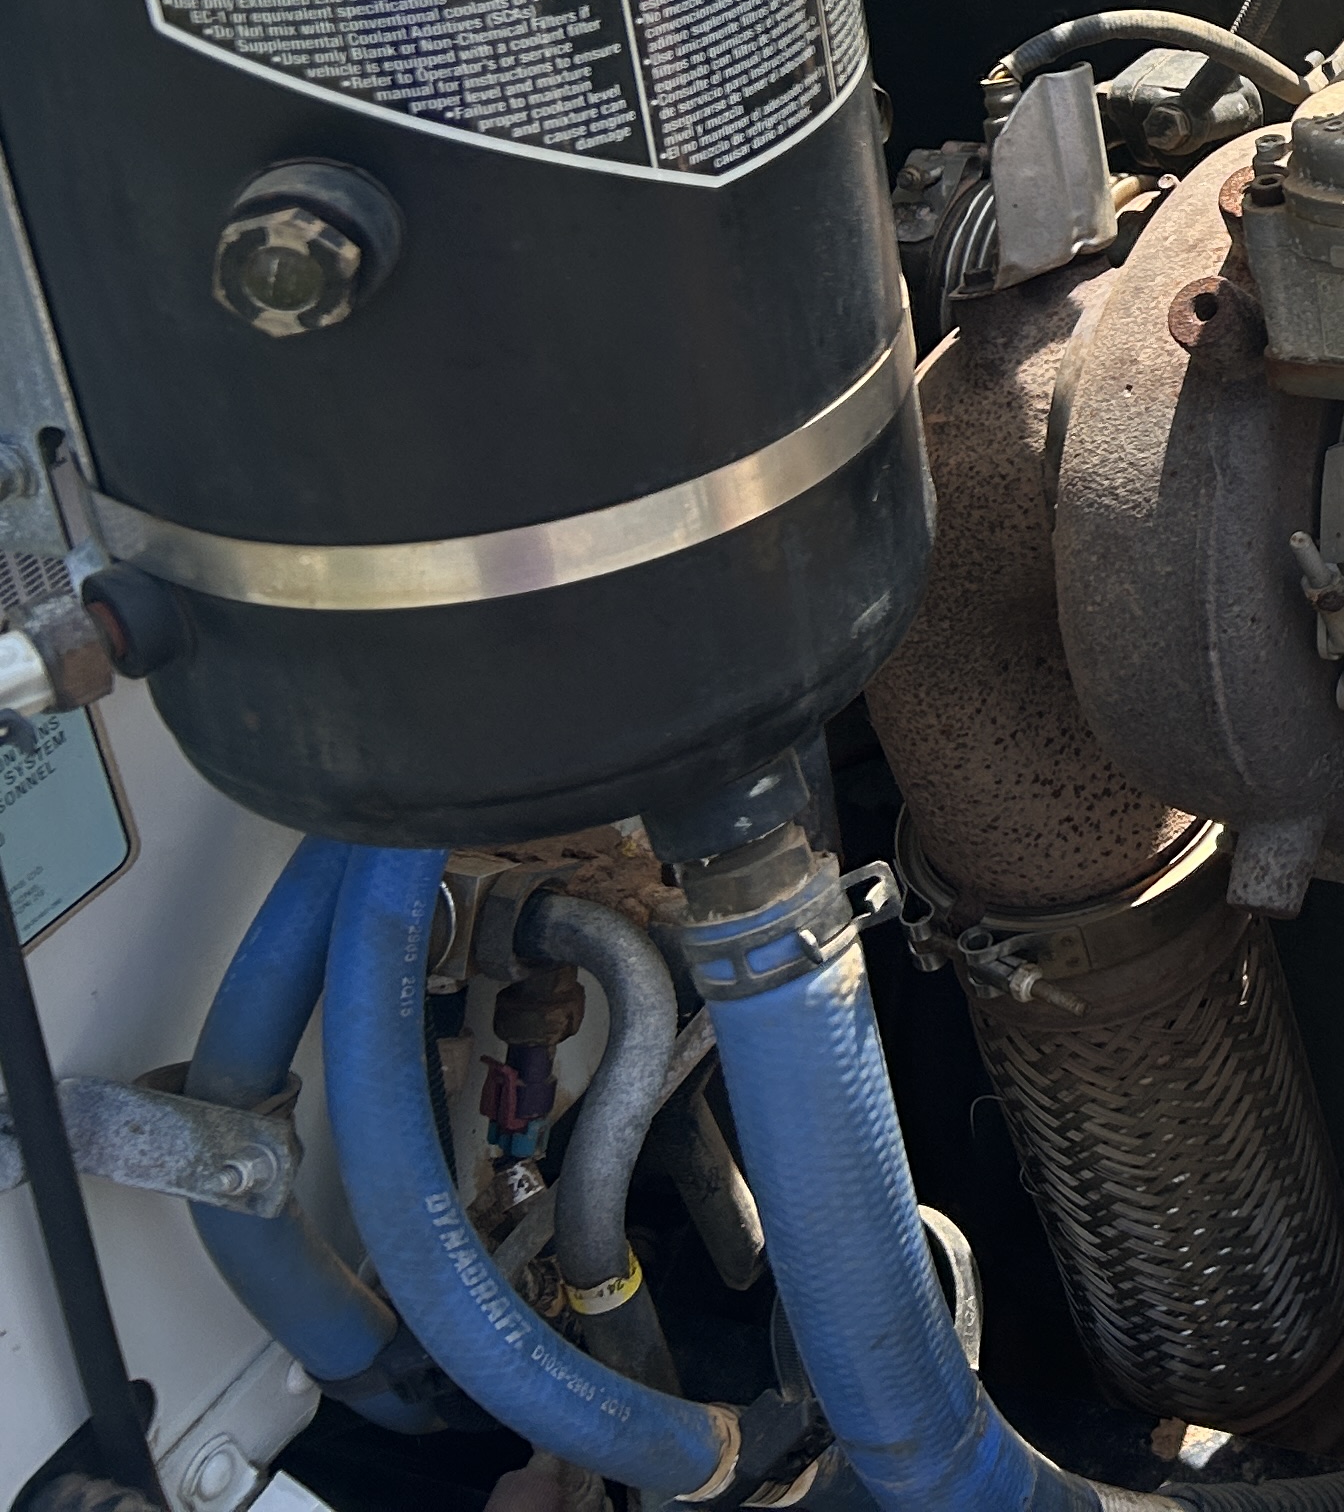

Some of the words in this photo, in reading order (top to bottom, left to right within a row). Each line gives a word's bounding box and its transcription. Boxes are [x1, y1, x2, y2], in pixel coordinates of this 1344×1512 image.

[214, 26, 235, 38] Do
[269, 25, 297, 36] mix
[301, 22, 335, 35] with
[340, 9, 440, 32] conventional
[229, 11, 248, 23] or
[252, 6, 333, 24] equivalent
[235, 36, 343, 54] Supplemental
[347, 26, 407, 46] Coolant
[410, 17, 482, 37] Additives
[485, 5, 537, 28] (SCAs)
[280, 52, 310, 65] Use
[314, 49, 347, 65] only
[351, 44, 398, 61] Blank
[400, 43, 416, 56] or
[418, 21, 528, 52] Non-Chemical
[530, 12, 577, 31] Filters
[578, 4, 591, 18] if
[305, 63, 361, 79] vehicle
[365, 61, 380, 73] is
[383, 51, 456, 73] equipped
[458, 45, 494, 60] with
[495, 43, 507, 53] a
[508, 28, 565, 51] coolant
[566, 19, 601, 37] filter
[351, 75, 393, 89] Refer
[394, 72, 413, 85] to
[499, 55, 516, 67] or
[518, 42, 573, 63] service
[374, 84, 435, 101] manual
[436, 80, 460, 93] for
[462, 62, 554, 88] instructions
[555, 57, 571, 69] to
[572, 43, 622, 65] ensure
[408, 94, 462, 115] proper
[462, 86, 501, 103] level
[503, 79, 533, 96] and
[534, 66, 592, 89] mixture
[453, 101, 507, 120] Failure
[508, 96, 526, 109] to
[527, 81, 592, 106] maintain
[477, 110, 529, 133] proper
[530, 95, 587, 119] coolant
[586, 84, 621, 105] level
[511, 120, 541, 138] and
[541, 108, 599, 130] mixture
[600, 99, 627, 115] can
[543, 125, 588, 145] cause
[588, 110, 637, 133] engine
[574, 126, 632, 151] damage
